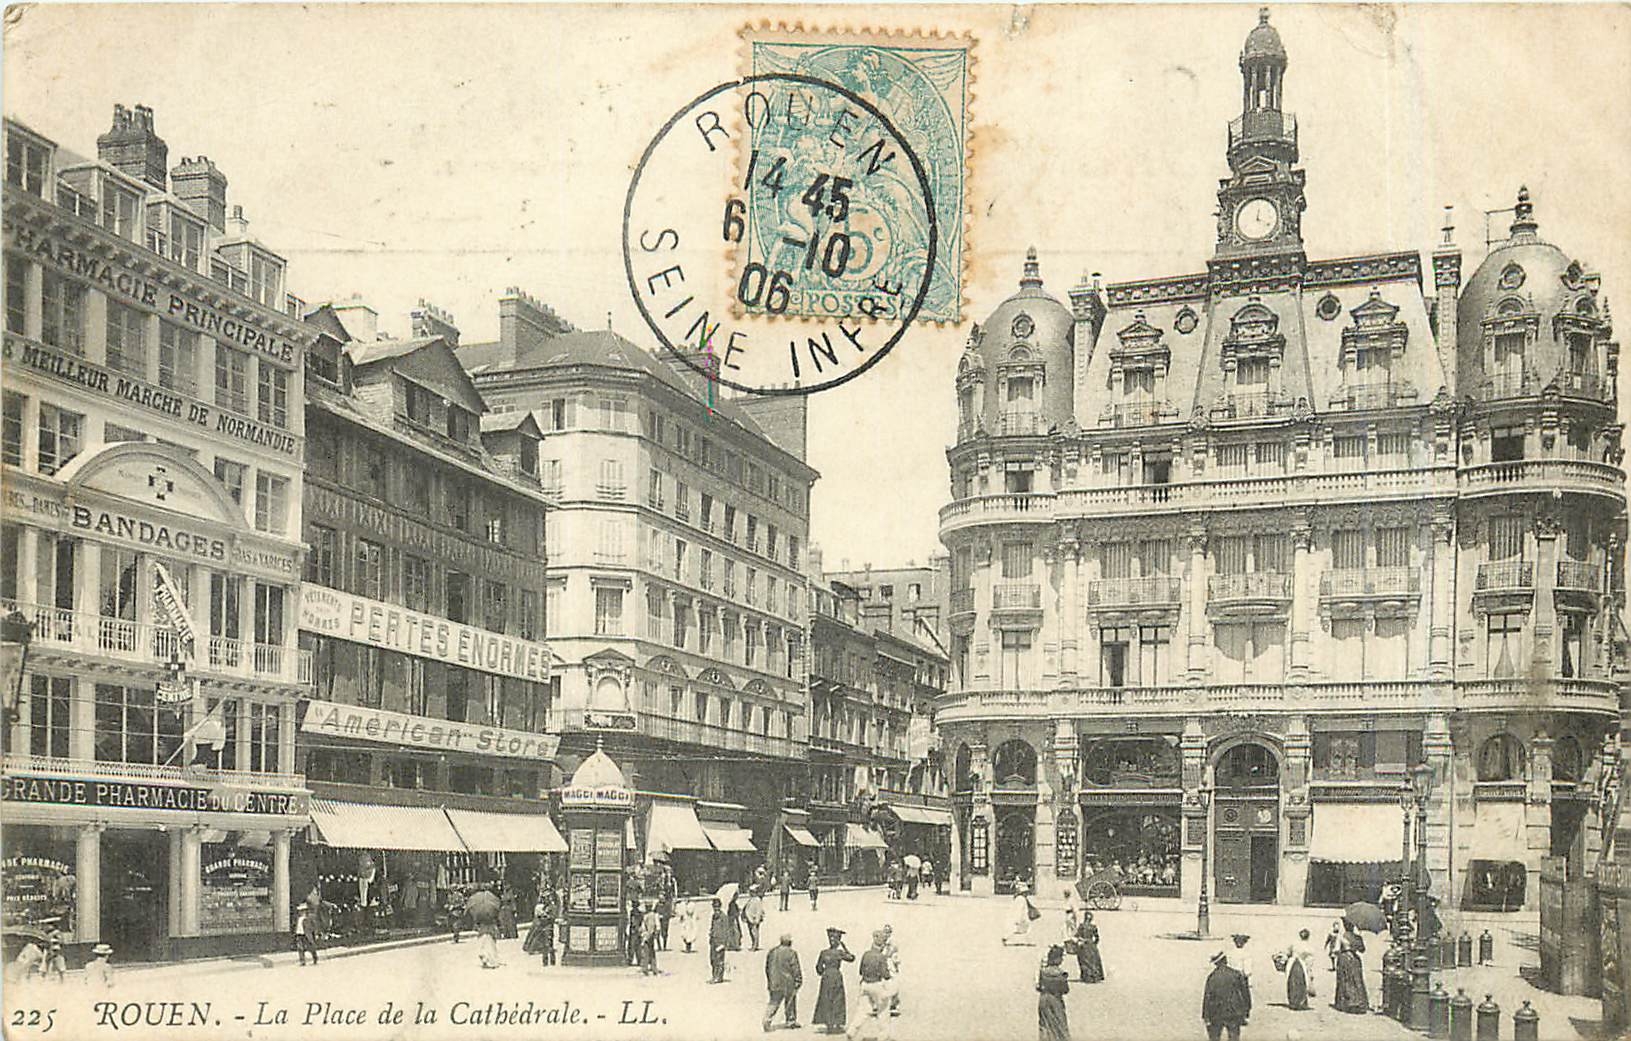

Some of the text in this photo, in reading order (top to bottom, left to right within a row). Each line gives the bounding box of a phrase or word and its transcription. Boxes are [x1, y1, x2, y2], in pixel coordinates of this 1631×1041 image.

[168, 294, 294, 363] PRINCIPALE
[22, 343, 109, 393] MEILLEUR
[188, 404, 209, 426] DE
[216, 413, 296, 455] NORMANDIE
[71, 505, 225, 561] BANDAGES
[350, 601, 552, 681] PERTES ENORMES
[476, 729, 555, 758] Store
[0, 776, 298, 814] GRANDE PHARMACIE DU CENTRE
